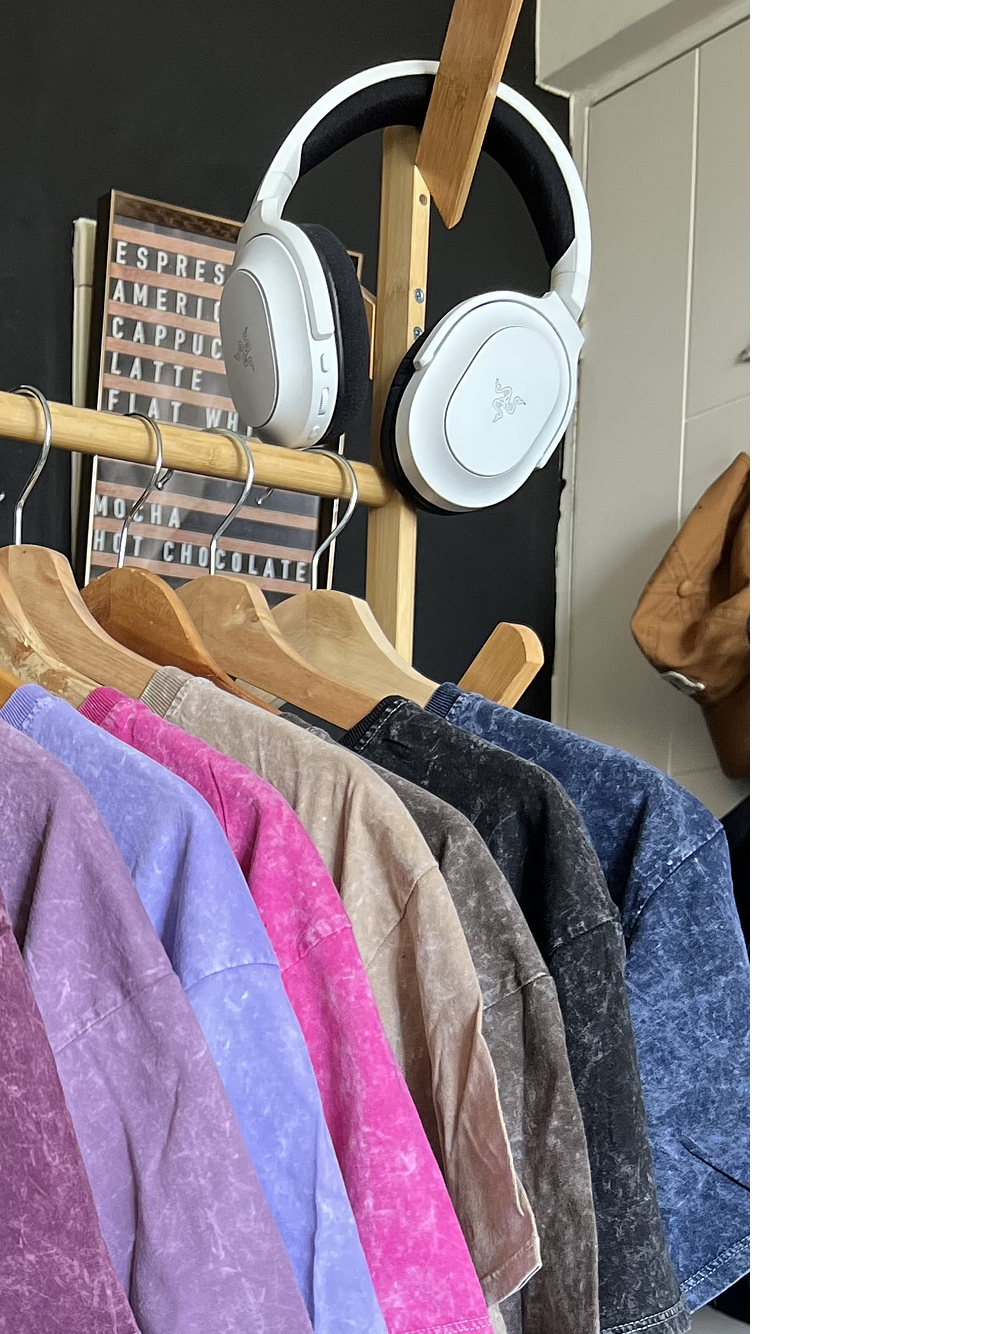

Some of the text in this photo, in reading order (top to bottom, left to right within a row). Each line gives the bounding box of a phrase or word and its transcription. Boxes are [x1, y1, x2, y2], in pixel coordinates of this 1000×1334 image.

[115, 241, 226, 286] ESPRES
[112, 317, 223, 360] CAPPUC
[110, 352, 203, 391] LATTE
[94, 494, 181, 529] MOCHA
[93, 529, 308, 582] HOT CHOCOLATE
